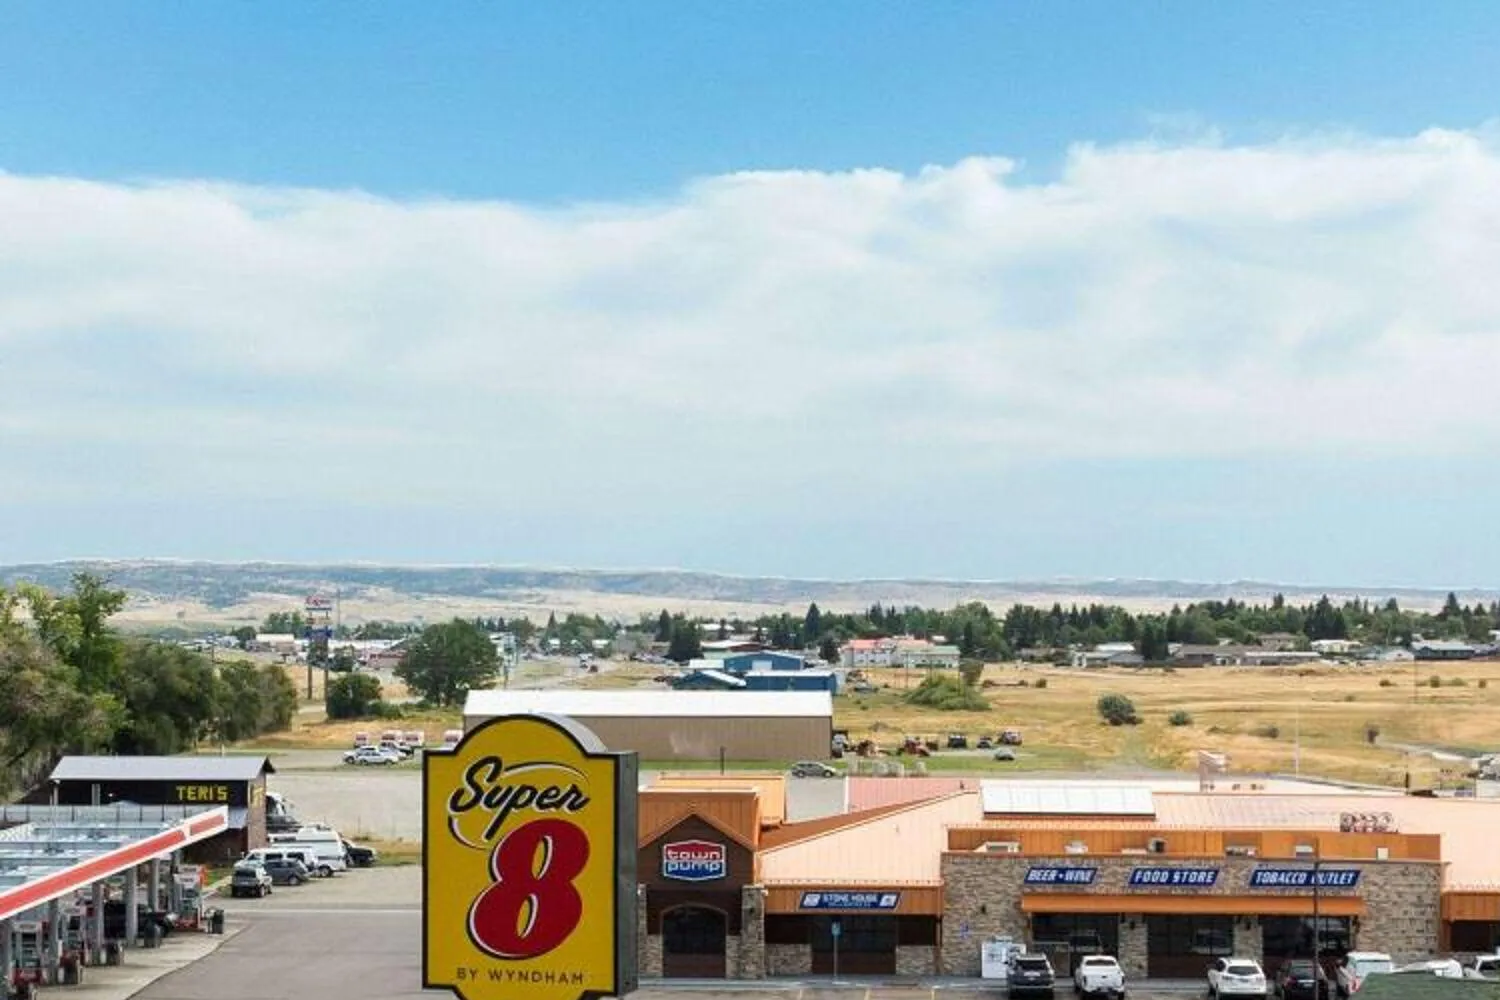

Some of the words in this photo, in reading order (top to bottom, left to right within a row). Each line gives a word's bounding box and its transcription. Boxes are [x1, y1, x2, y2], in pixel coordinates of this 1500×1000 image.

[176, 785, 228, 801] TERI'S
[448, 755, 591, 845] Super
[667, 849, 721, 860] town
[667, 861, 721, 873] pump
[1027, 869, 1058, 881] BEER
[1134, 870, 1169, 883] FOOD
[1172, 871, 1215, 883] STORE
[1255, 871, 1307, 885] TOBACCO
[466, 817, 591, 961] 8
[456, 966, 479, 981] BY
[487, 967, 585, 985] WYNDHAM
